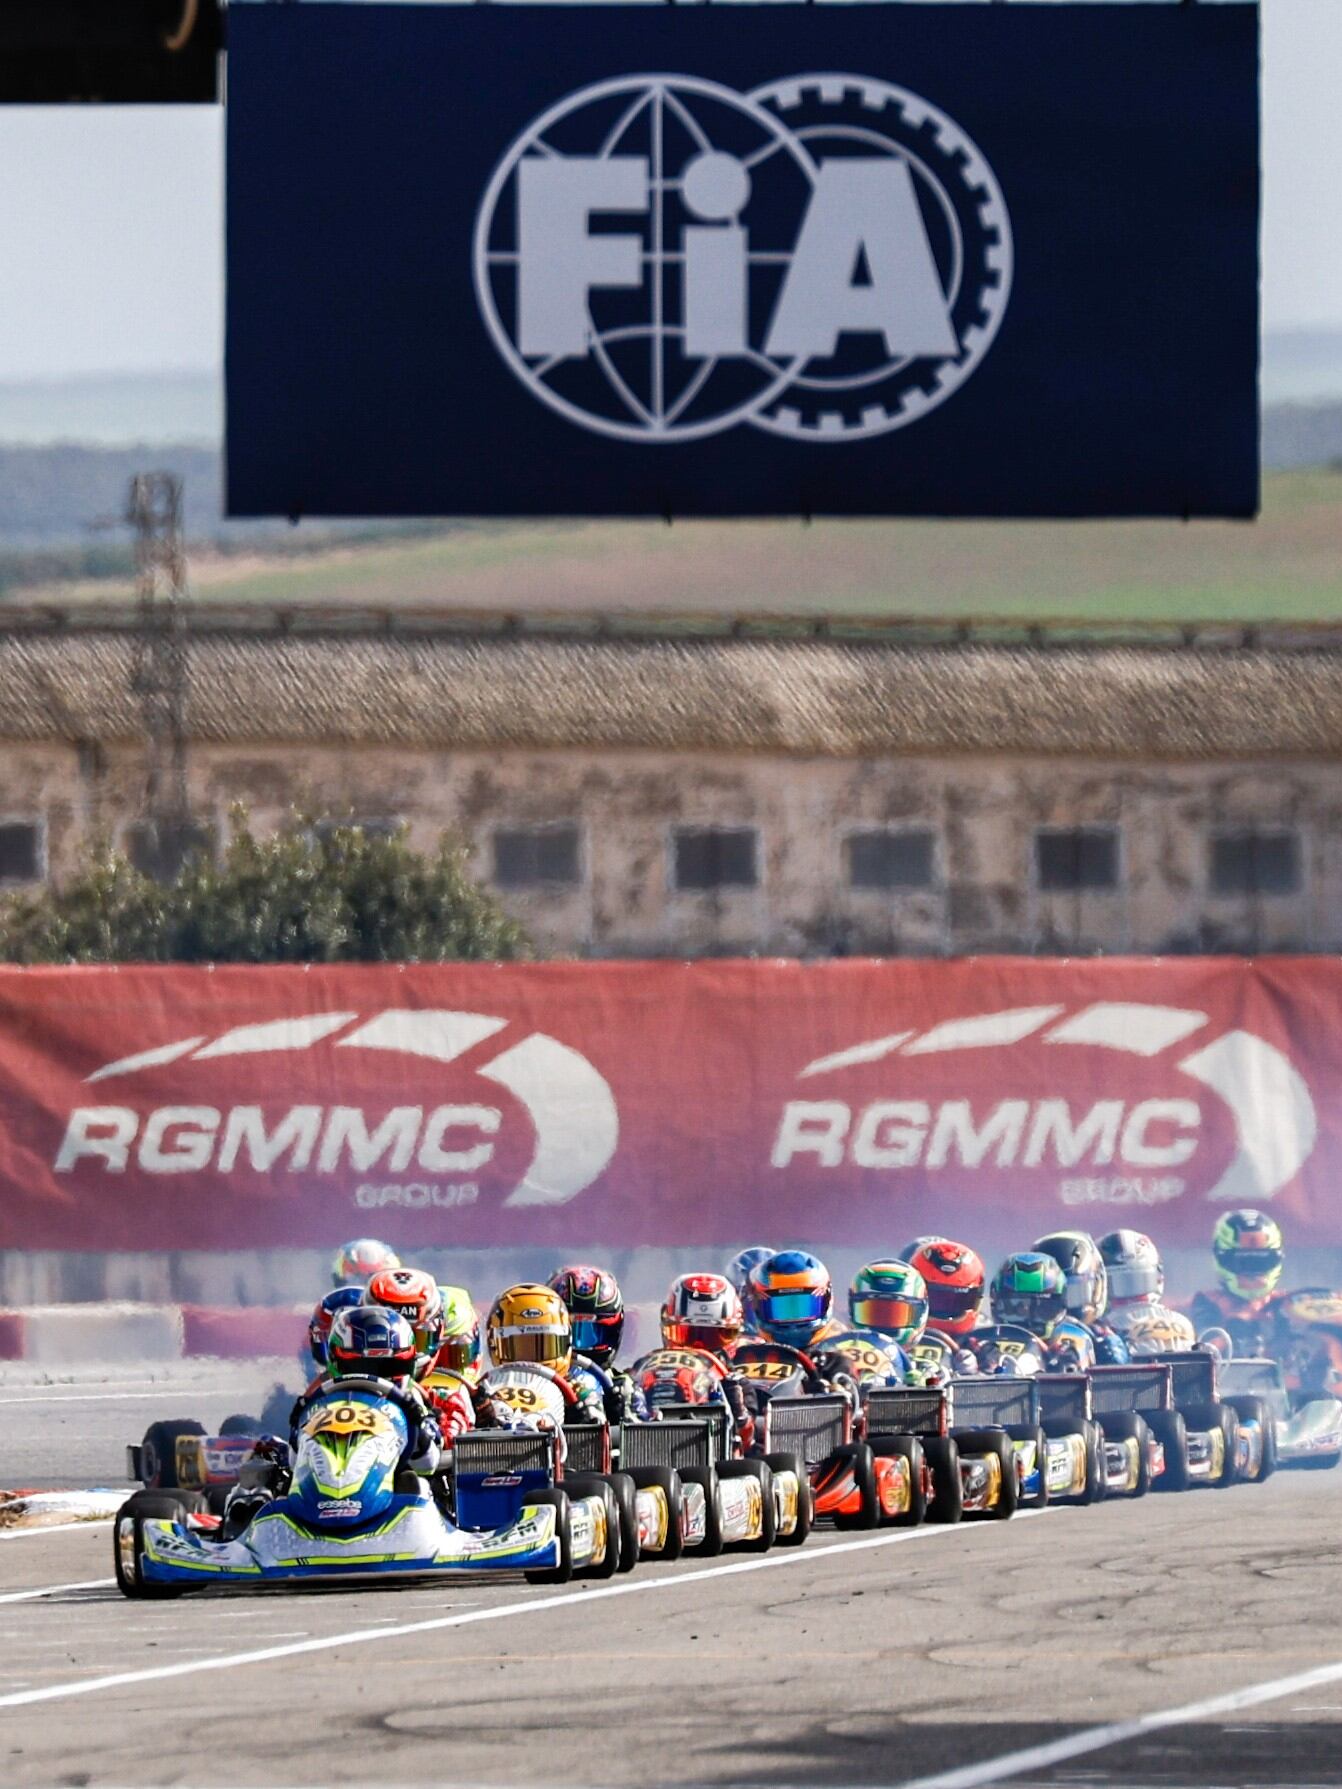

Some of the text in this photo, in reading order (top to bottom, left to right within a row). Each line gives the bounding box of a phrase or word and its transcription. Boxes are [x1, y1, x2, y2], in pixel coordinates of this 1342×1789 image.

[55, 1104, 501, 1173] RGMMC
[771, 1098, 1201, 1168] RGMMC
[313, 1406, 376, 1431] 203
